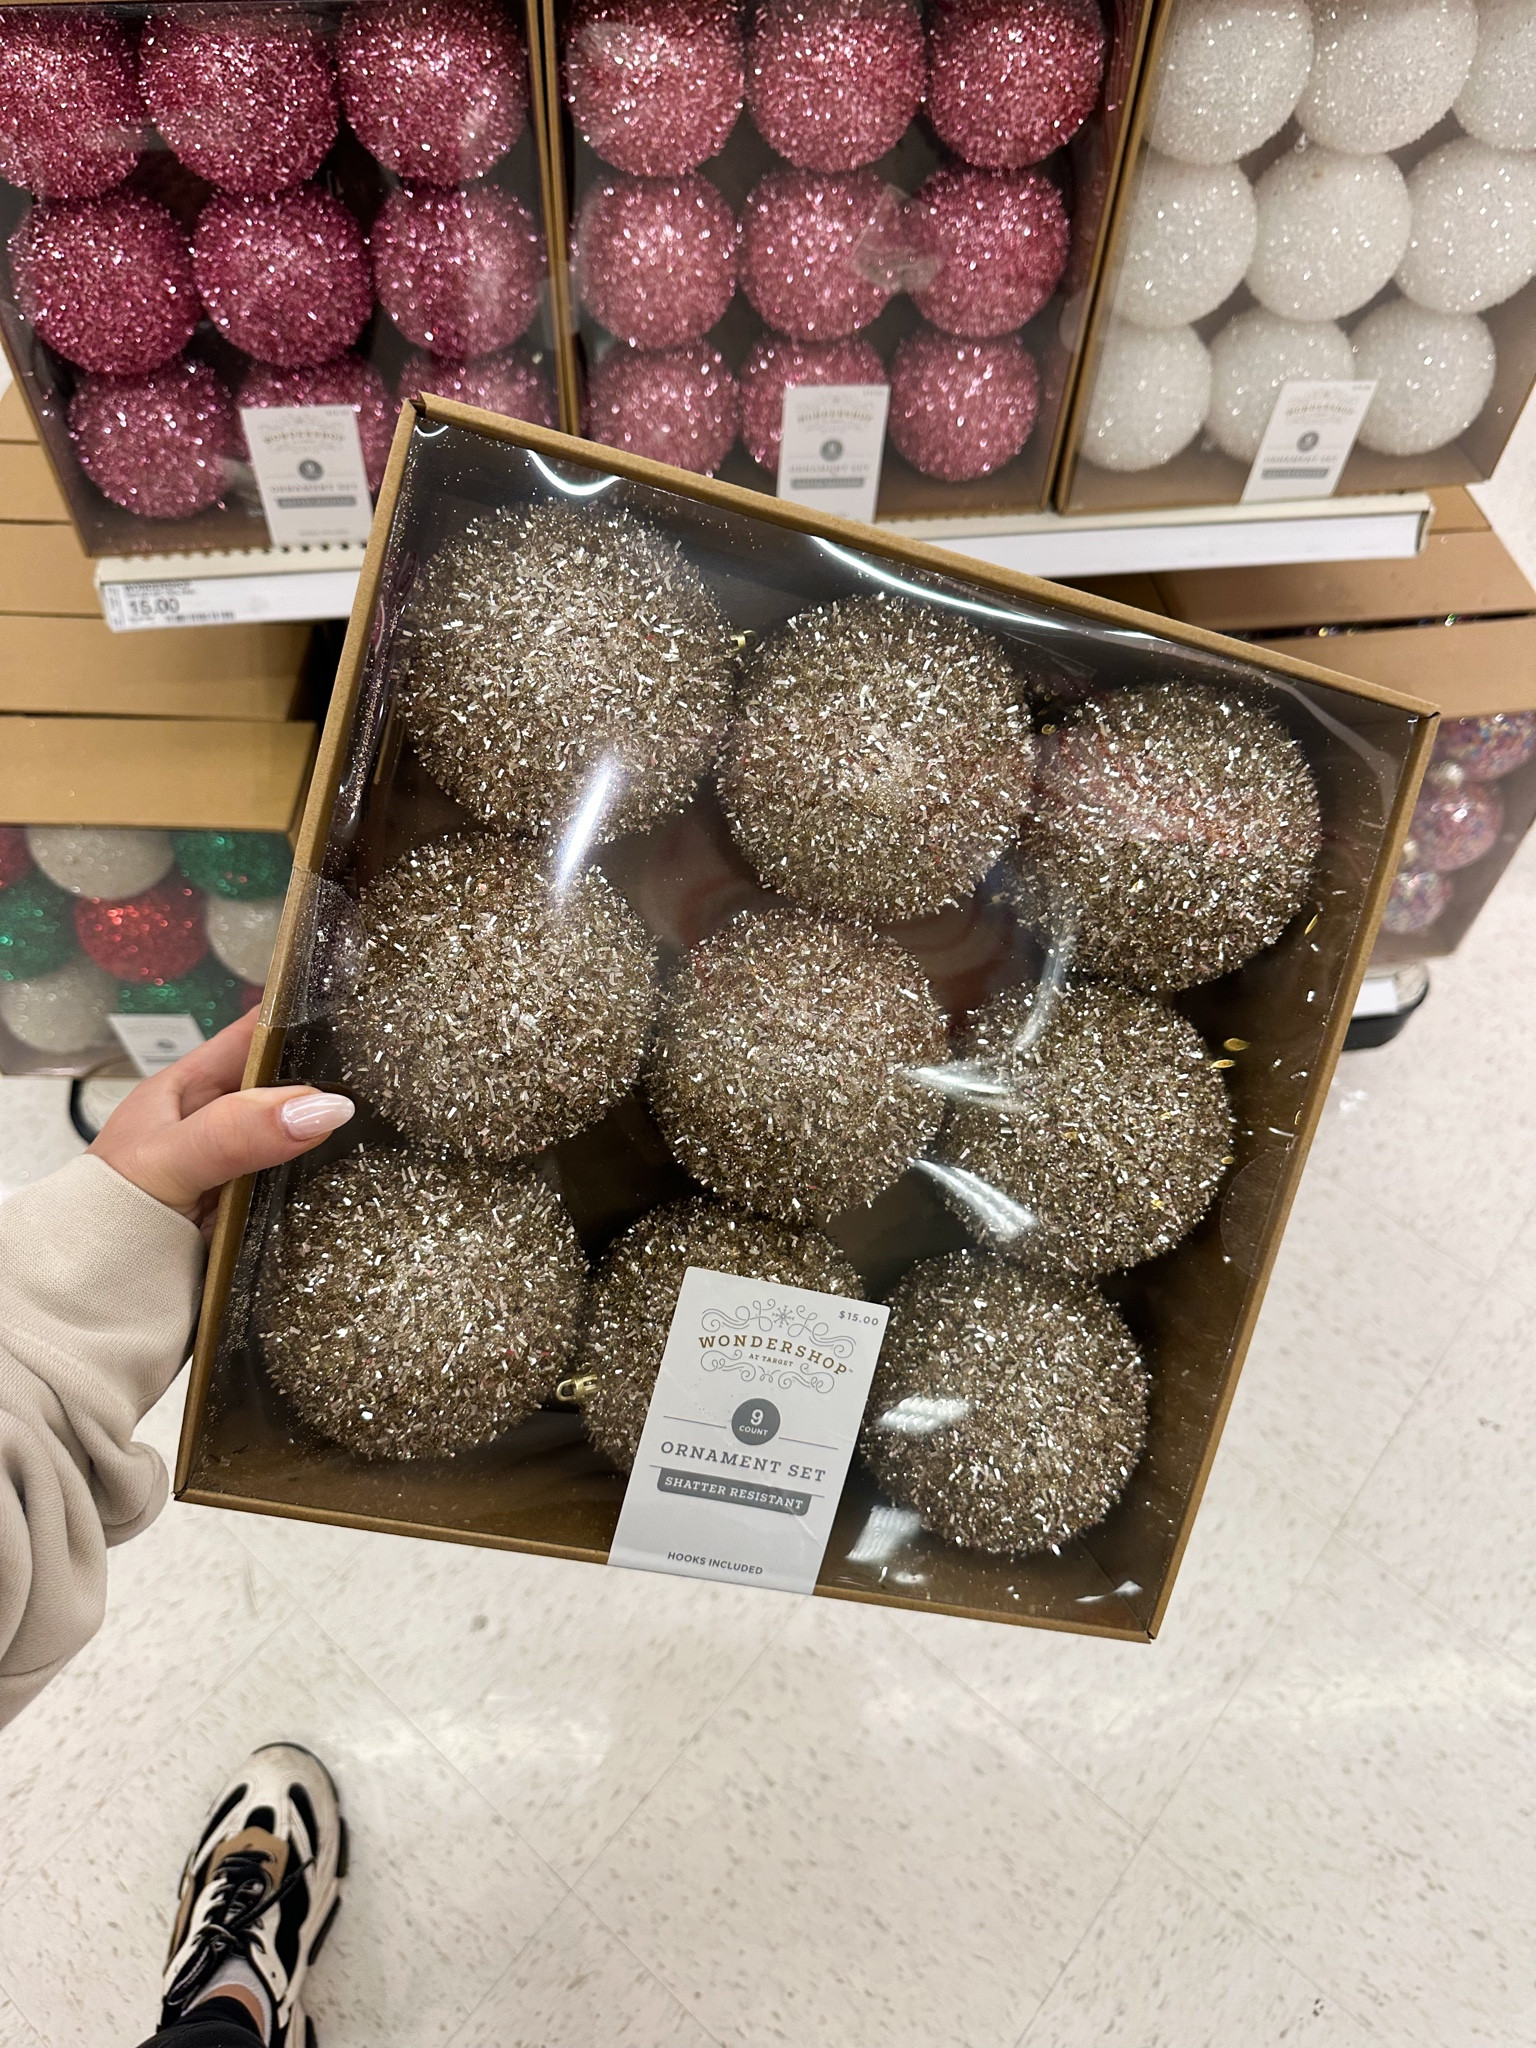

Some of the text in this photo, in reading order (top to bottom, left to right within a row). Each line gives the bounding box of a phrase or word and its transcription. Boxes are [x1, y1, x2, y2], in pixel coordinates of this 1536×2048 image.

[838, 1310, 879, 1326] $15.00
[699, 1334, 848, 1375] WONDERSHOP
[749, 1353, 794, 1367] AT TARGET
[750, 1408, 764, 1425] 9
[739, 1425, 768, 1436] COUNT
[661, 1441, 826, 1482] ORNAMENT SET
[664, 1476, 803, 1509] SHATTER RESISTANT
[667, 1551, 763, 1575] HOOKS INCLUDED
